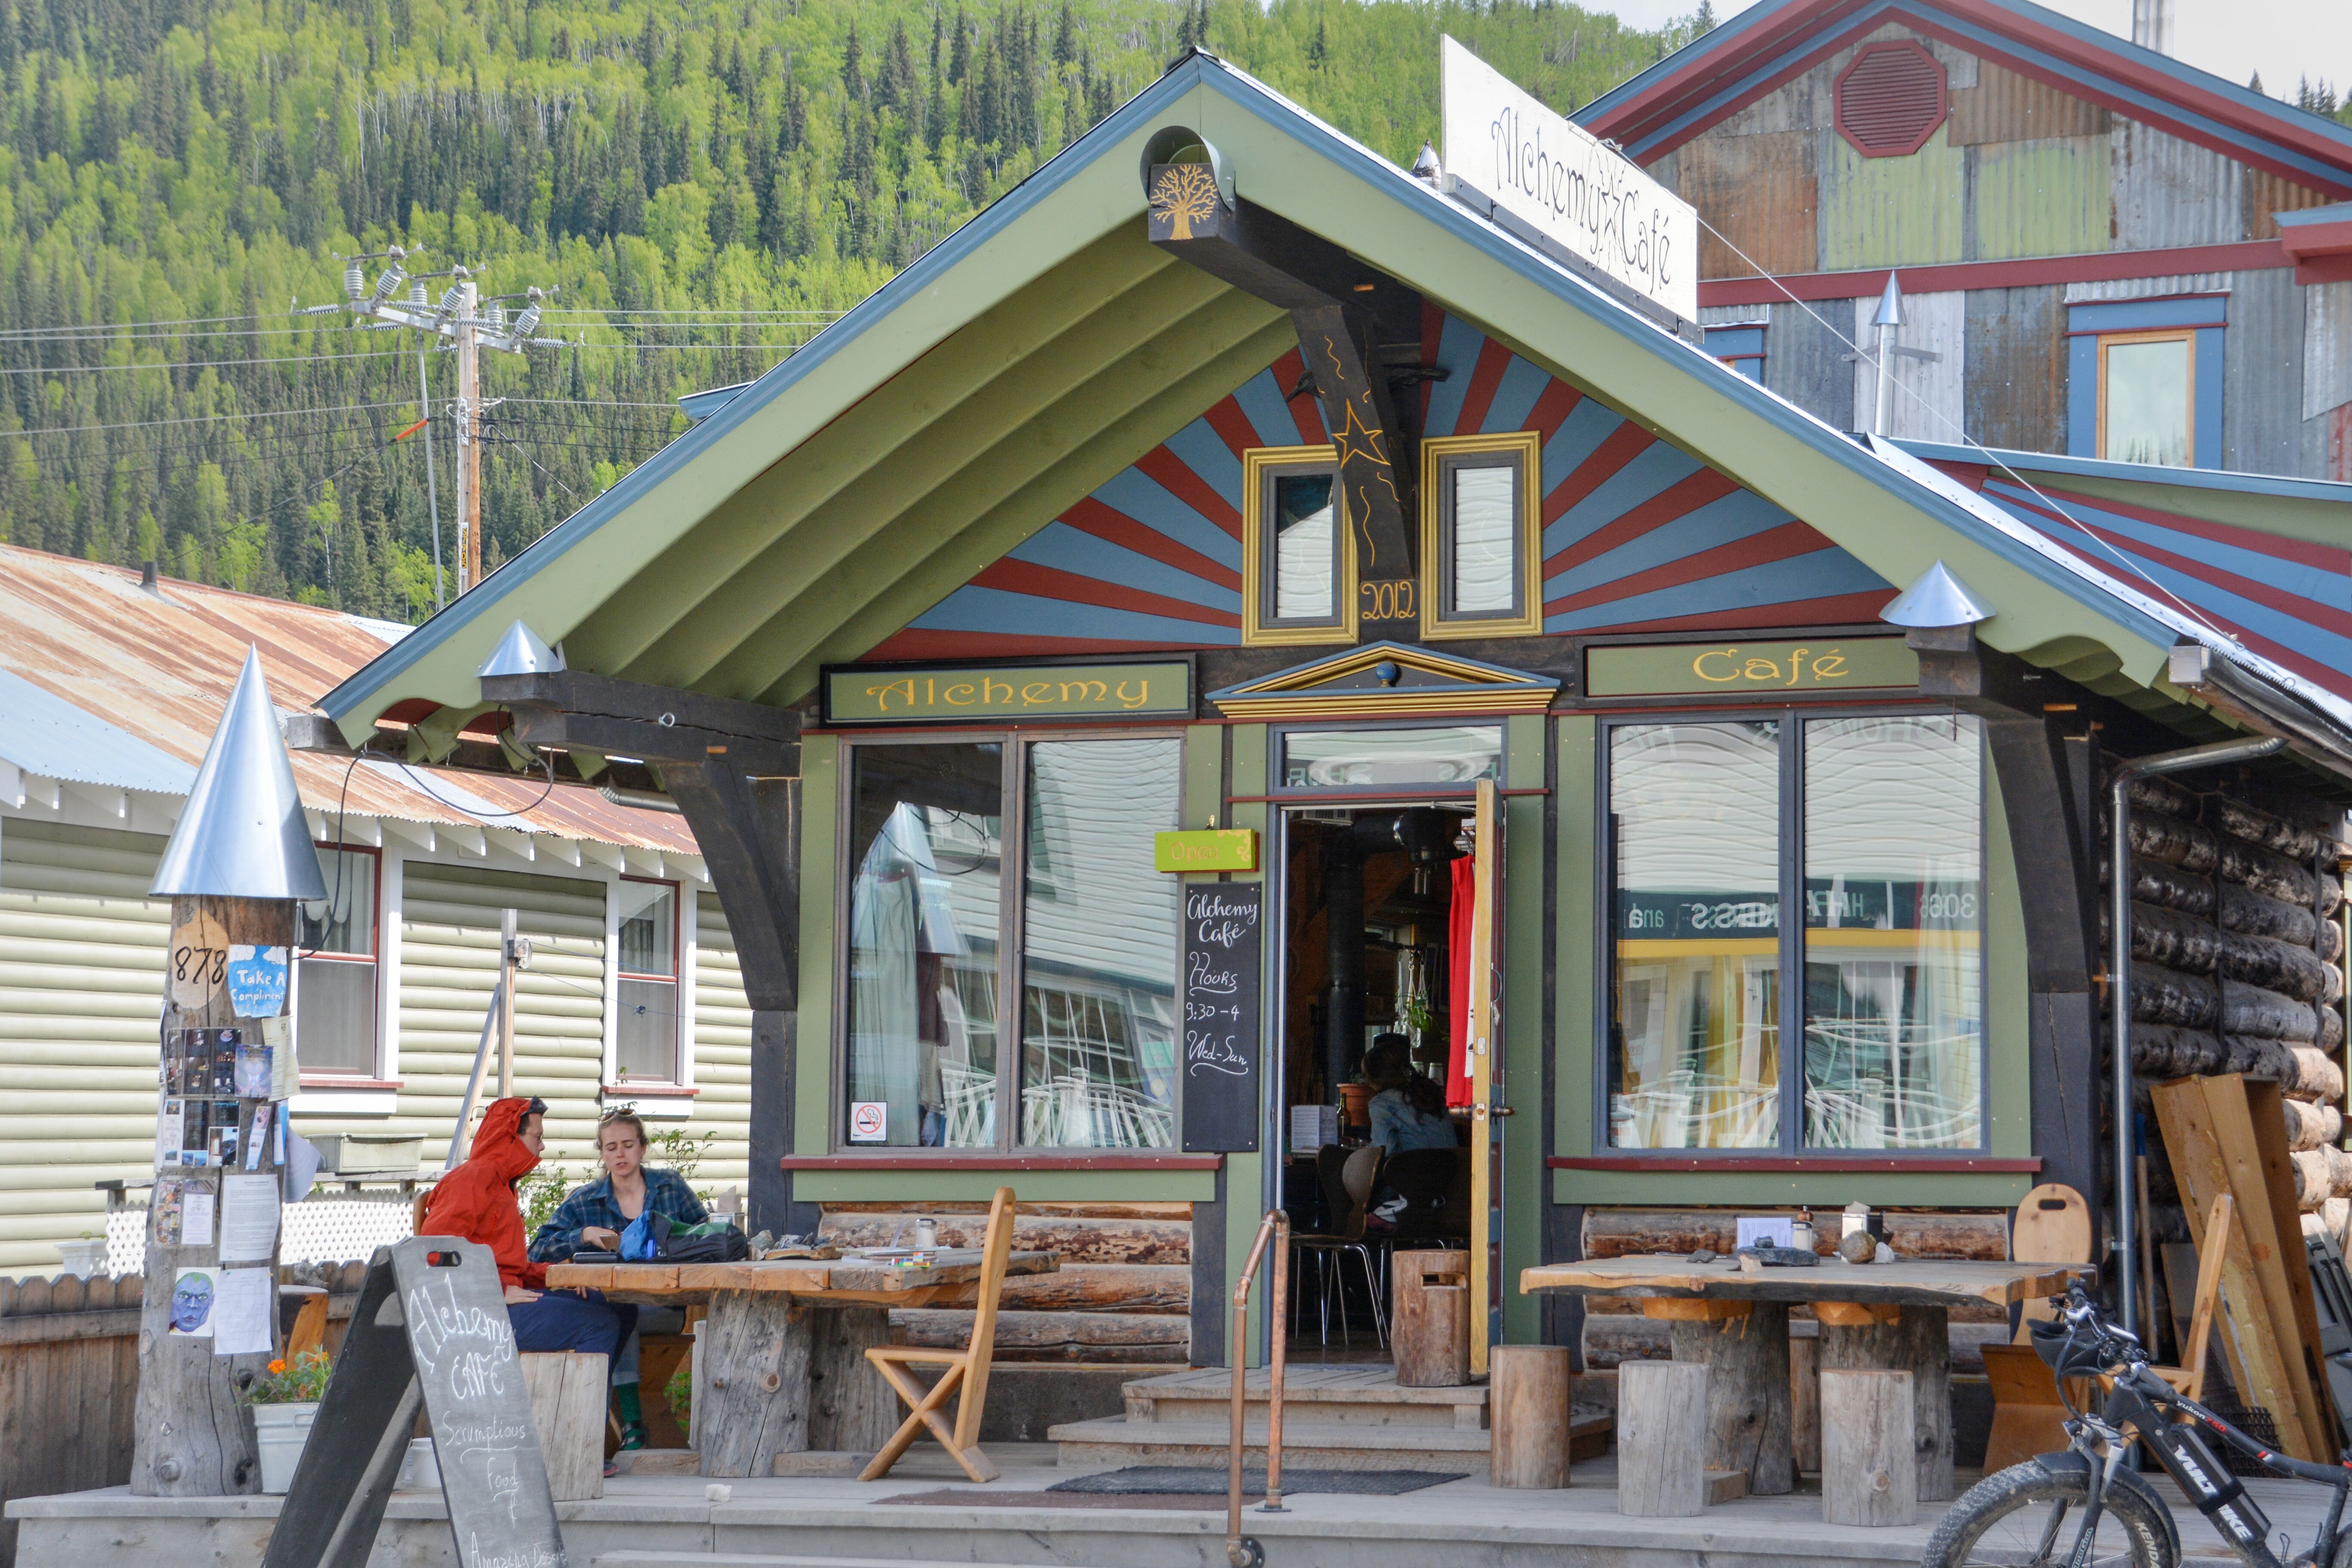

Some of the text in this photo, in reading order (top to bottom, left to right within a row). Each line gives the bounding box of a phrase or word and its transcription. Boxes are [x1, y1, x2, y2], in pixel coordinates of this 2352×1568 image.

[1491, 106, 1671, 296] Alchemy Café
[1360, 580, 1416, 620] 2012
[1693, 648, 1849, 686] Café
[866, 676, 1149, 711] Alchemy
[1170, 842, 1219, 865] Open
[1199, 919, 1246, 947] Café
[175, 946, 227, 985] 878
[275, 971, 286, 987] A
[230, 988, 285, 1005] Compliment
[409, 1272, 513, 1374] Alchemy
[442, 1410, 525, 1452] Scrumptious
[487, 1457, 519, 1490] Food
